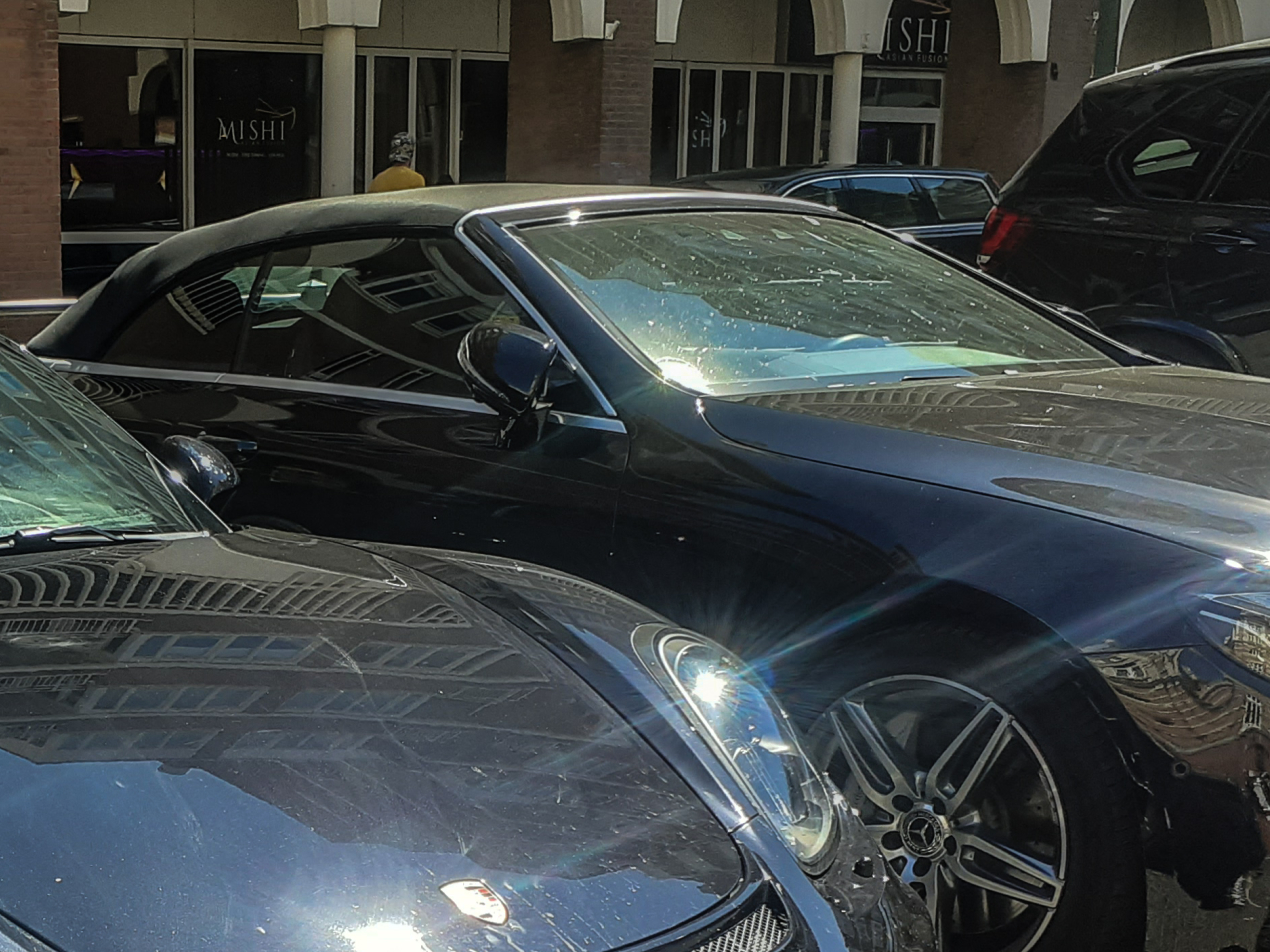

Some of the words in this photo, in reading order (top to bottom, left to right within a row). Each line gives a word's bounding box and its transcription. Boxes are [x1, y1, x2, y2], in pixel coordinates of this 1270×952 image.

[878, 17, 951, 55] ISHI
[886, 54, 914, 62] ASIAN
[217, 117, 285, 144] MISHI
